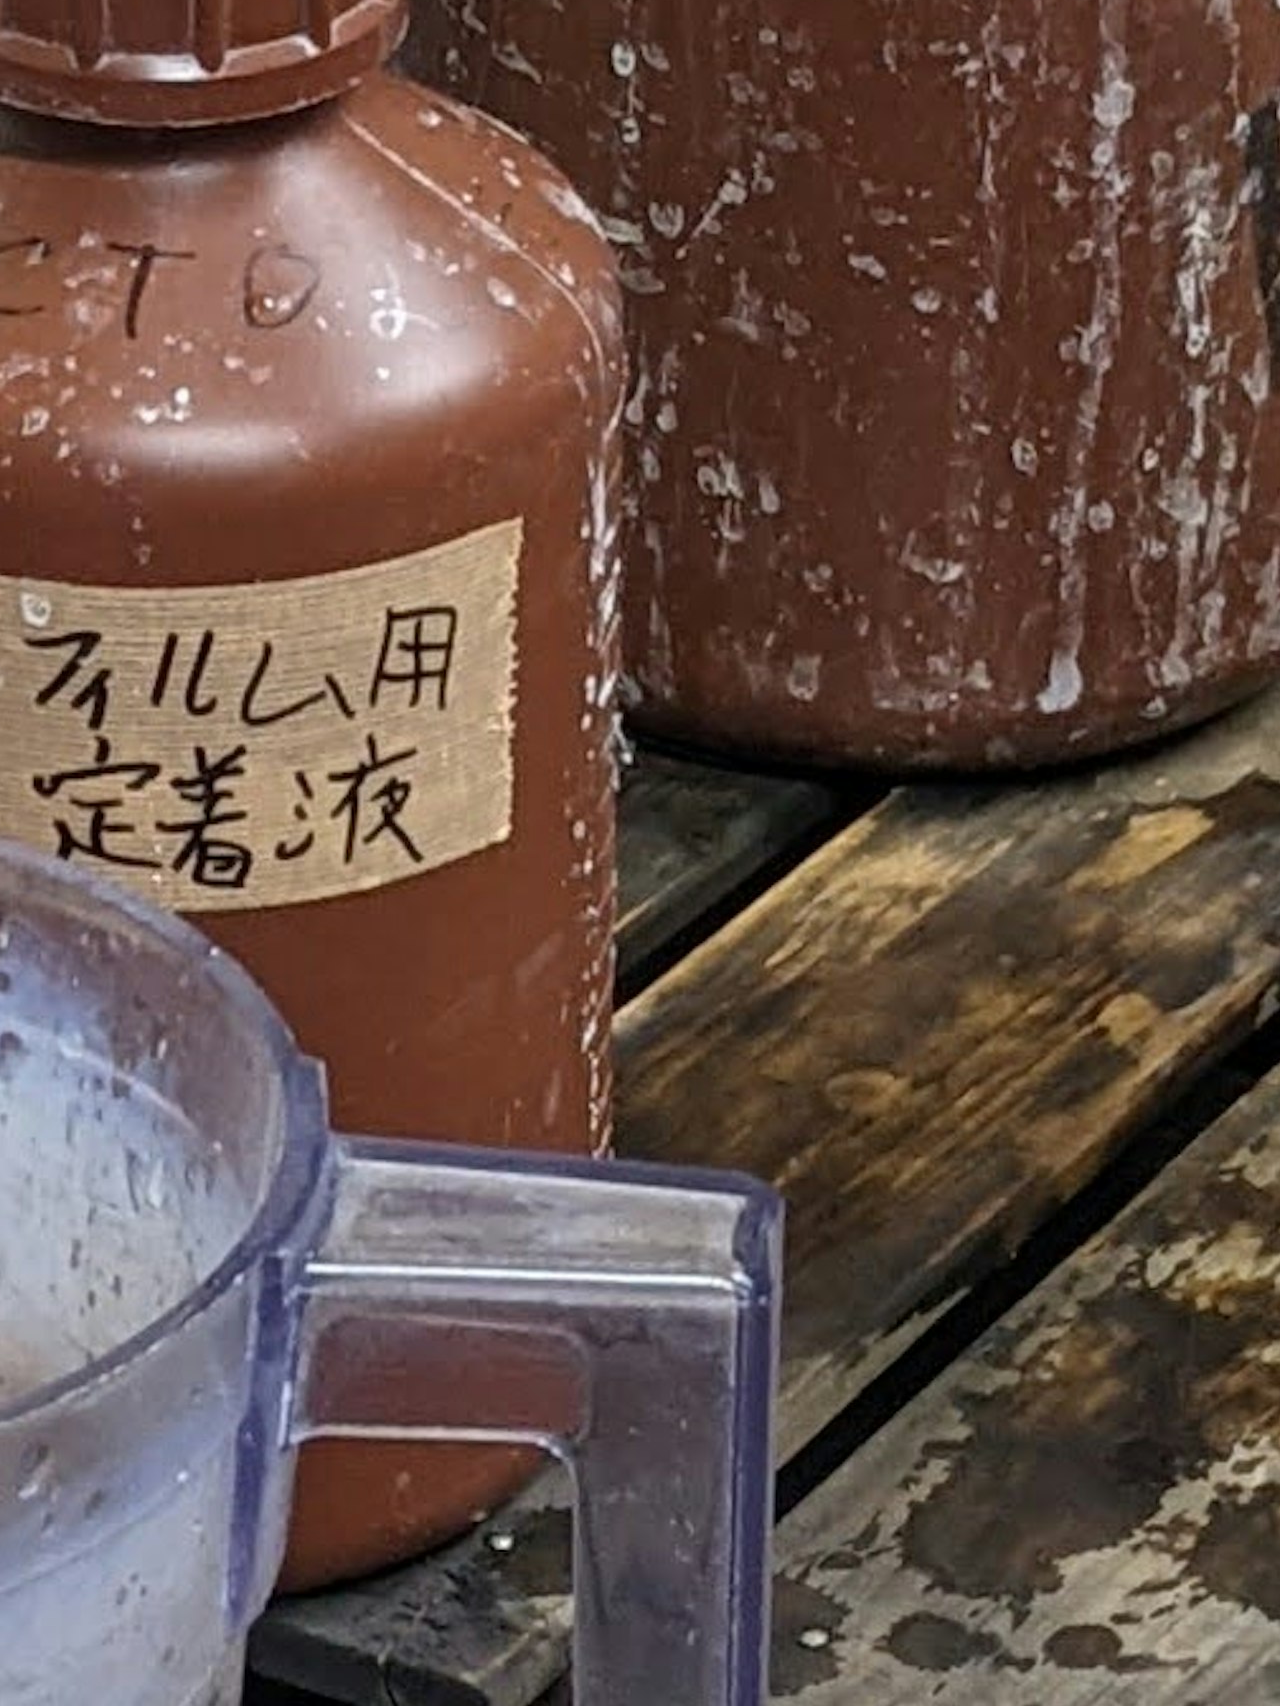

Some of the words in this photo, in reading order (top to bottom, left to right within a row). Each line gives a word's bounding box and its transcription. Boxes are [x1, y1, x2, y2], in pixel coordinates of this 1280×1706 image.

[24, 603, 460, 731] フィルム用
[31, 732, 427, 893] 定着液
